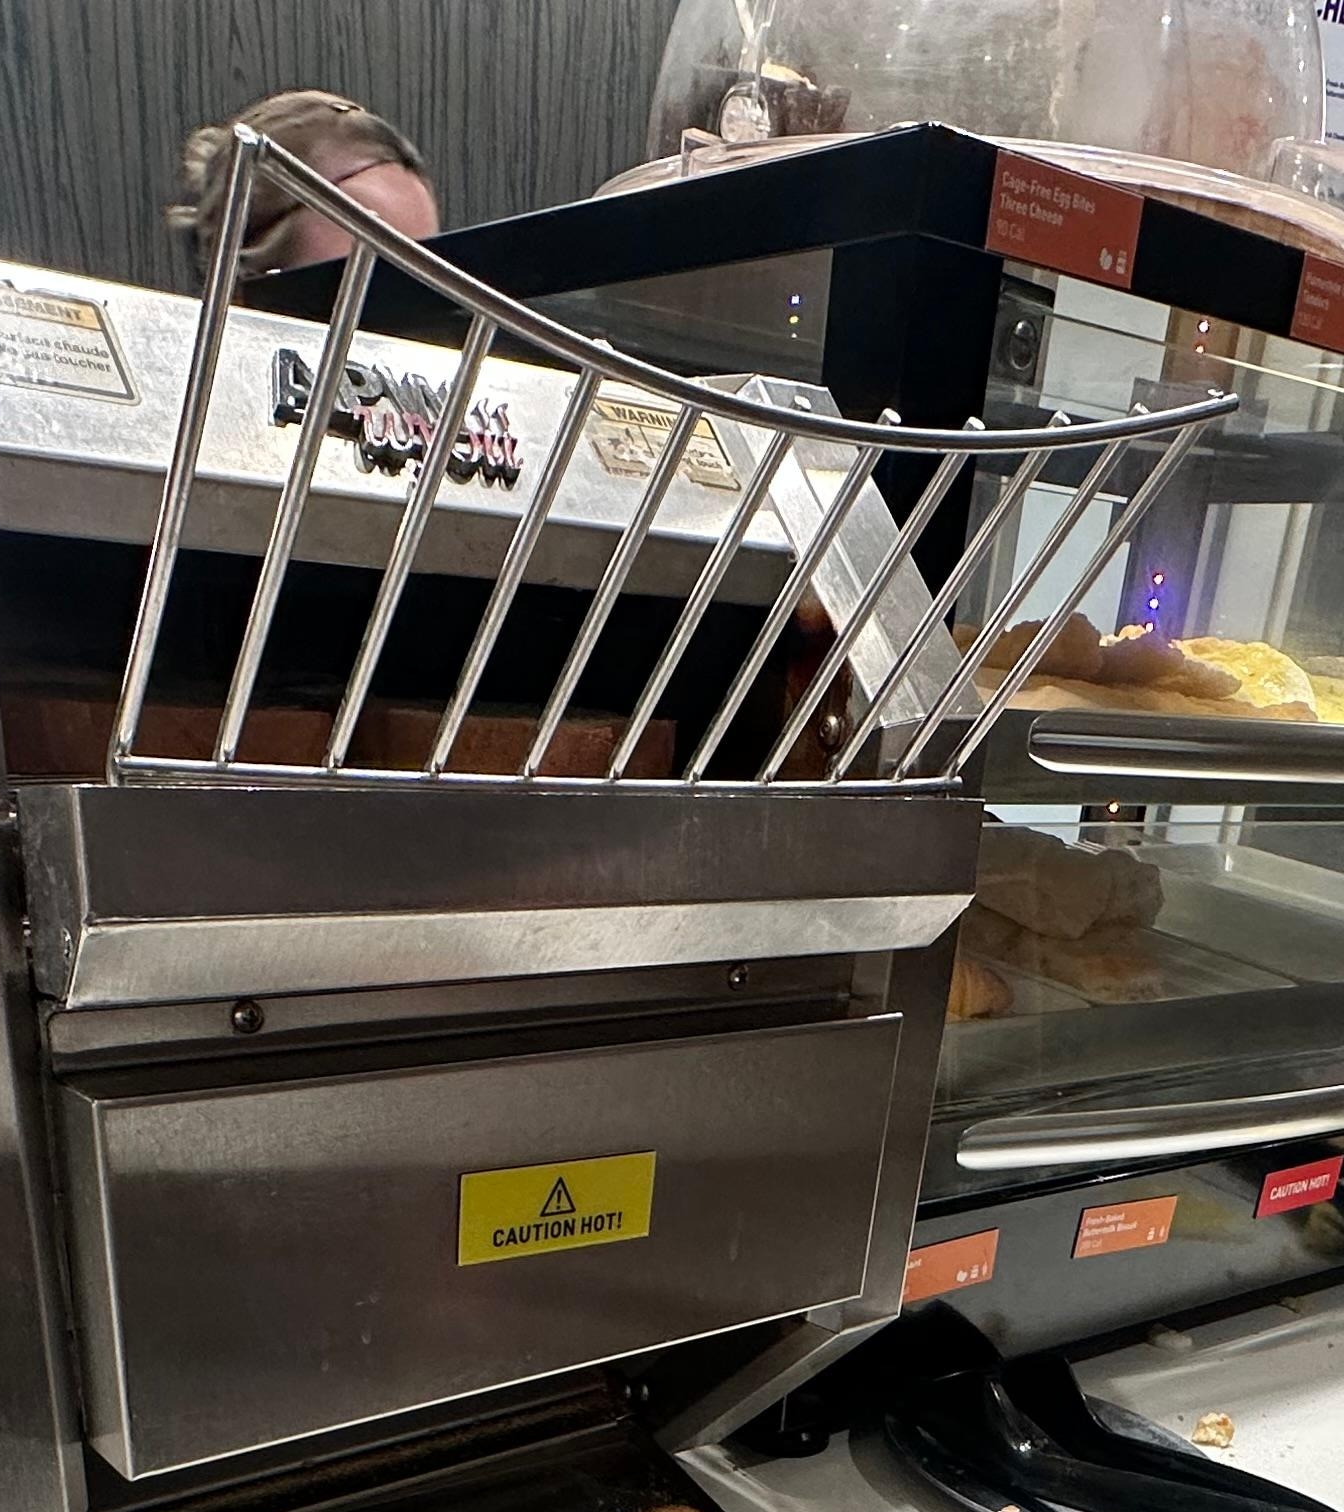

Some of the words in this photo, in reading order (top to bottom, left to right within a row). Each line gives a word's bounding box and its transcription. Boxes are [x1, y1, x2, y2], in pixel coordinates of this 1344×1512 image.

[1002, 171, 1052, 200] Cage-Free
[1053, 187, 1071, 209] Egg
[1072, 194, 1096, 214] Bites
[1000, 193, 1028, 215] Three
[1029, 202, 1064, 226] Cheese
[55, 350, 111, 373] toucher
[611, 406, 676, 429] WARNIN
[1269, 1179, 1309, 1200] CAUTION
[1308, 1173, 1331, 1191] HOT!
[492, 1218, 576, 1248] CAUTION
[580, 1211, 623, 1235] HOT!
